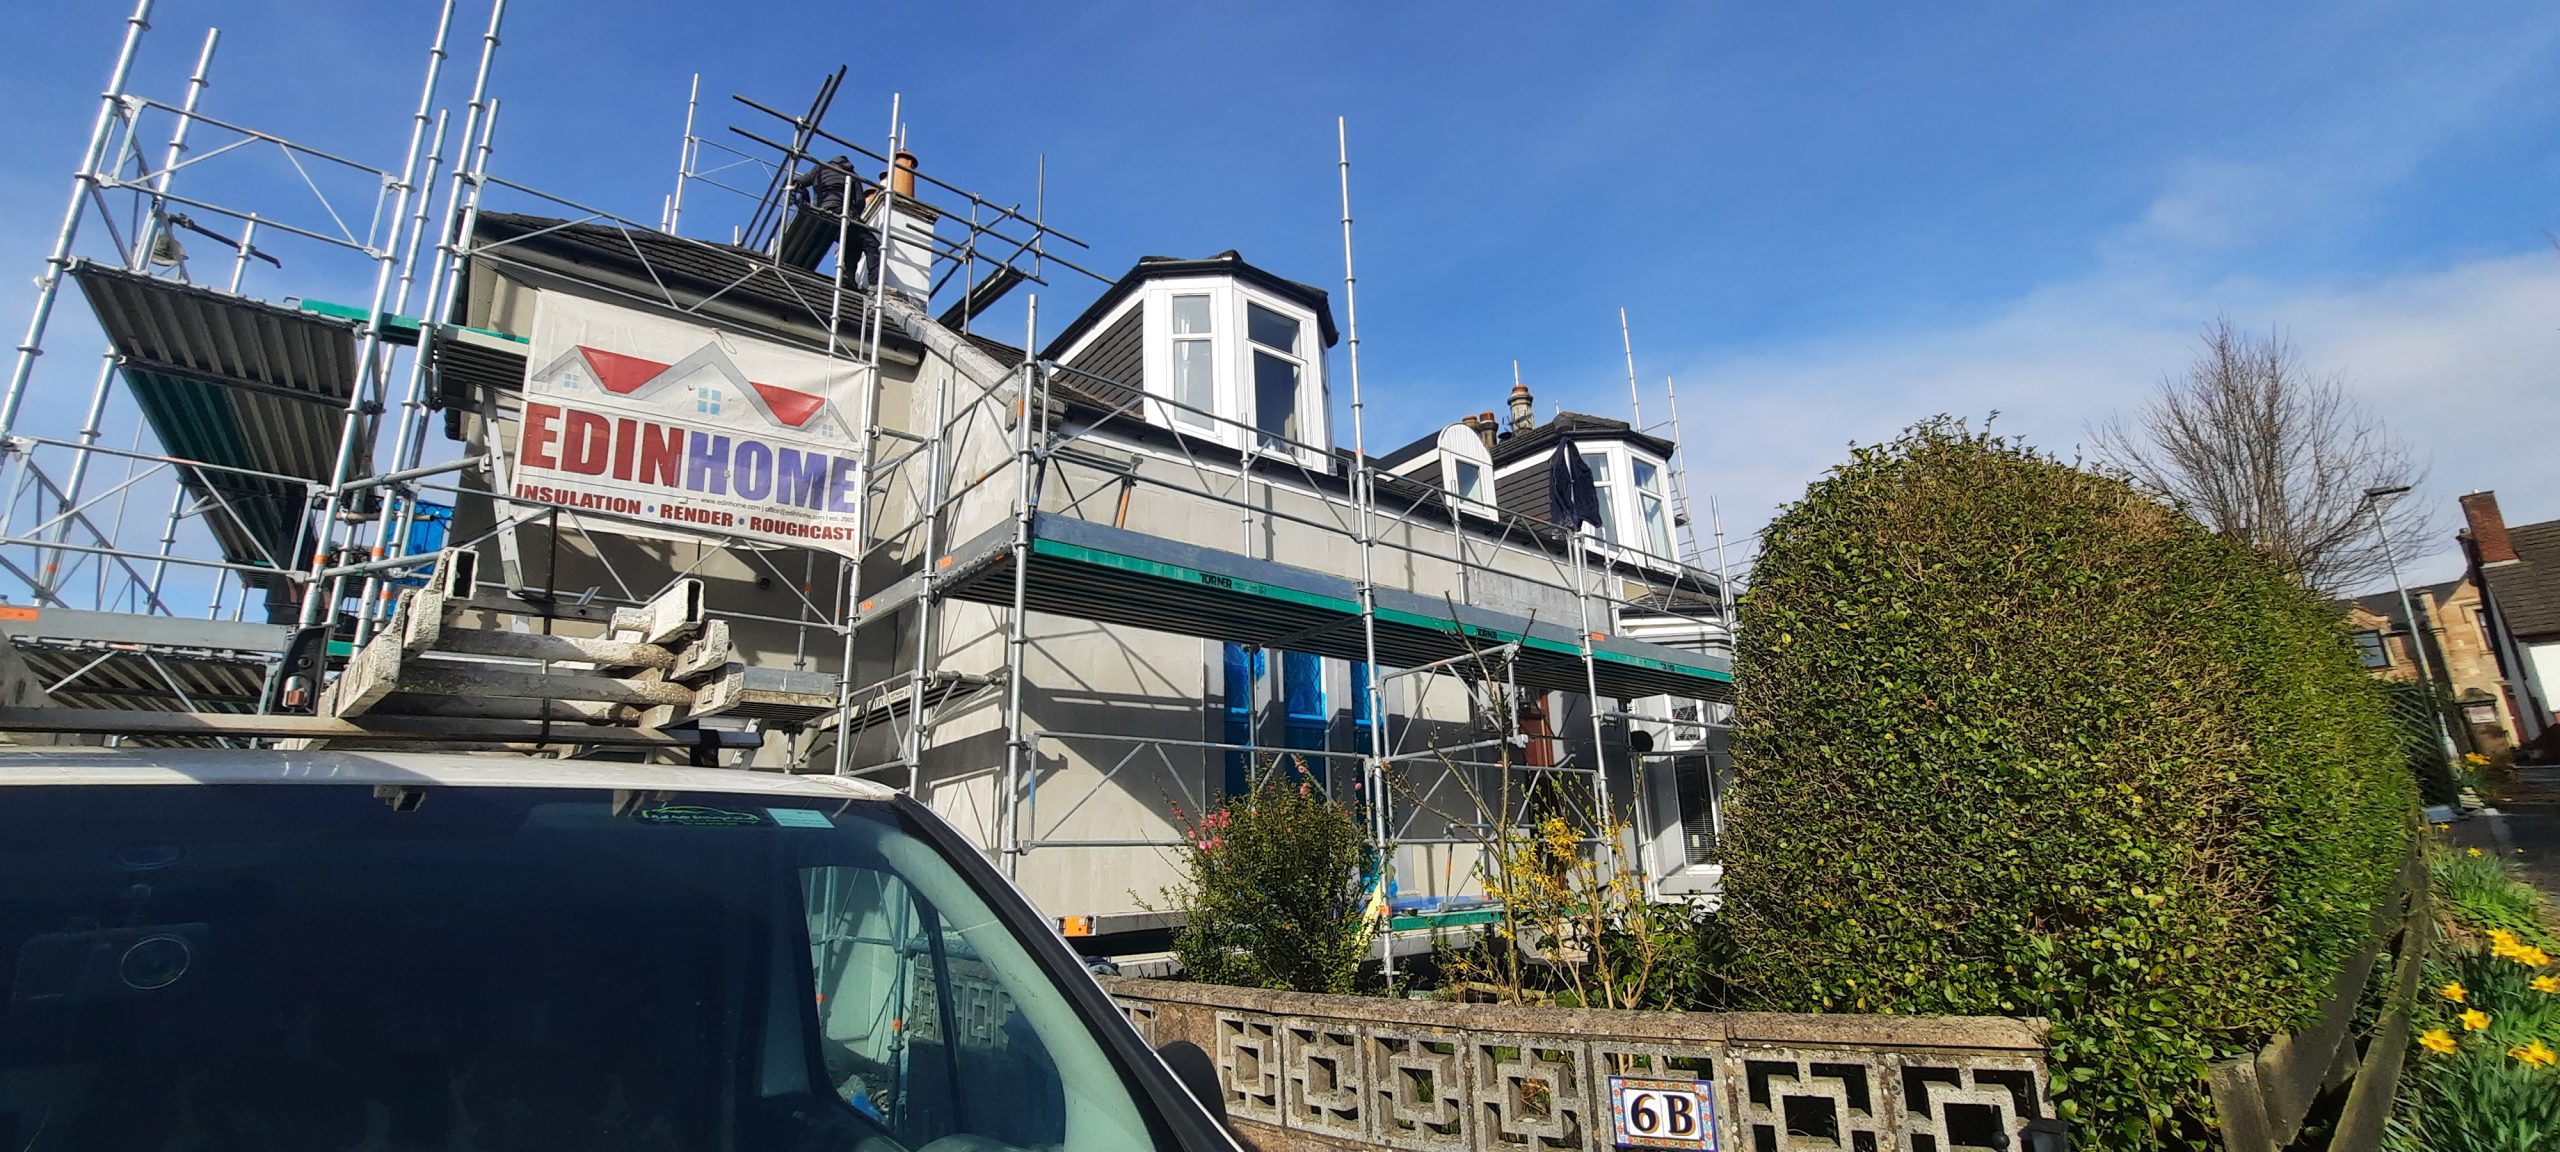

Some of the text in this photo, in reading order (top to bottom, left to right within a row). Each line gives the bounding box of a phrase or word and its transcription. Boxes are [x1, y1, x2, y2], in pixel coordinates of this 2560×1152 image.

[520, 402, 856, 513] EDINHOME
[515, 484, 855, 541] INSULATION RENDER ROUGHCAST
[1631, 1093, 1697, 1137] 6B
